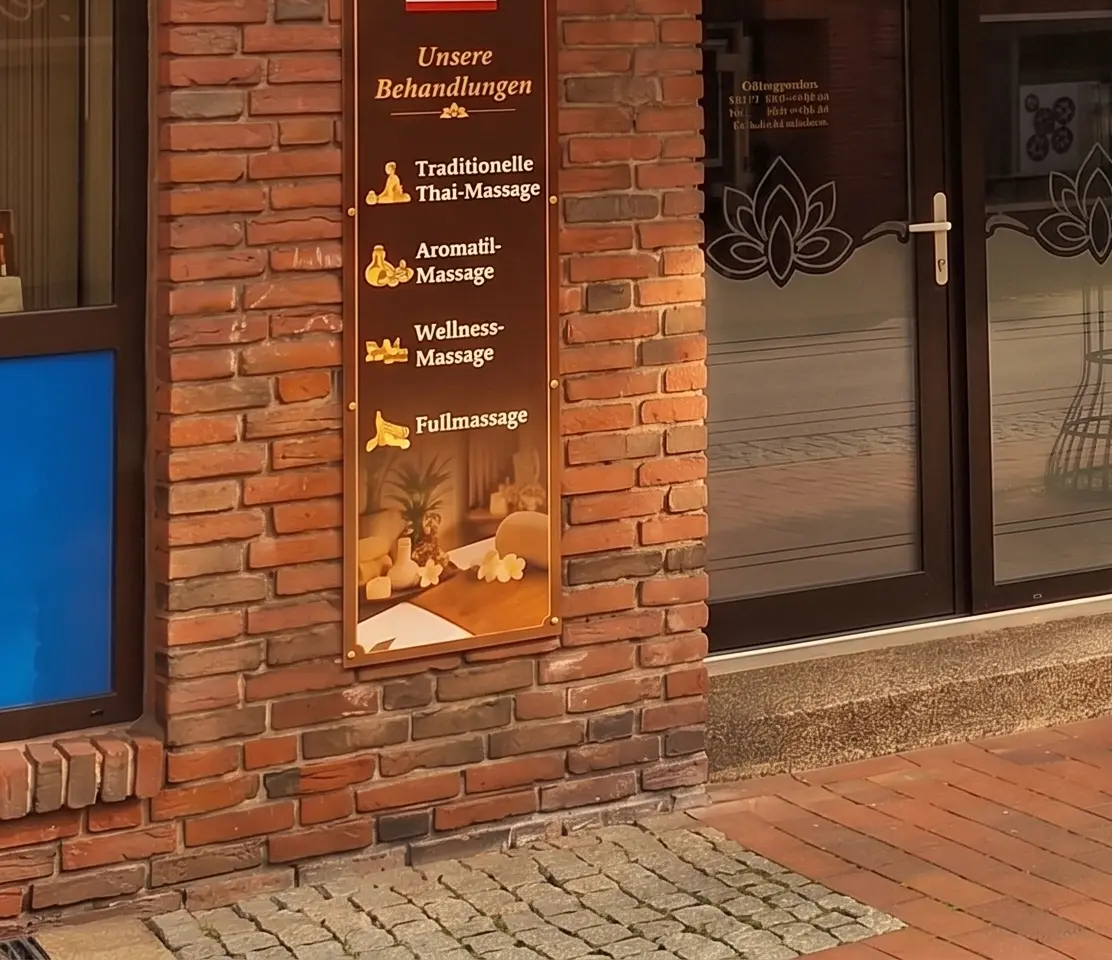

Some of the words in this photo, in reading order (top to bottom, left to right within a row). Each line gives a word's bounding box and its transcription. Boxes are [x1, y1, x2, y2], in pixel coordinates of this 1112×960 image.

[417, 46, 494, 68] Unsere
[374, 75, 533, 102] Behandlungen
[414, 155, 535, 178] Traditionelle
[415, 181, 542, 203] Thai-Massage
[415, 263, 495, 286] Massage
[413, 320, 505, 342] Wellness-
[415, 347, 495, 368] Massage
[415, 408, 529, 434] Fullmassage
